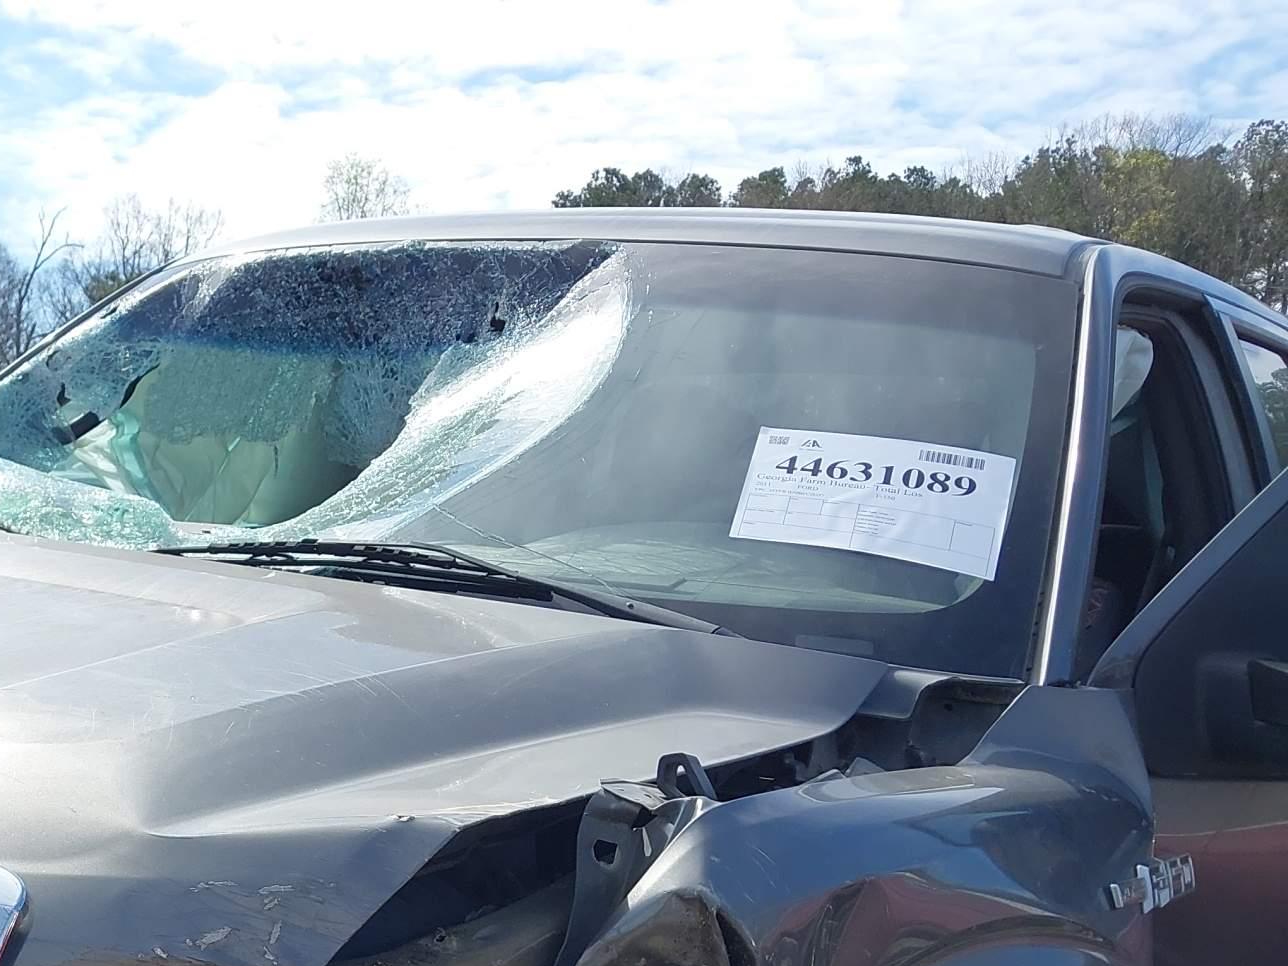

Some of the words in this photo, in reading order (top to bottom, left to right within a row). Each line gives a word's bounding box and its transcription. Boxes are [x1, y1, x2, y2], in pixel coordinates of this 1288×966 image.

[757, 472, 797, 483] Georgia
[800, 476, 826, 485] Farm
[875, 484, 901, 495] Total
[775, 455, 977, 496] 44631089
[797, 484, 820, 492] FORD
